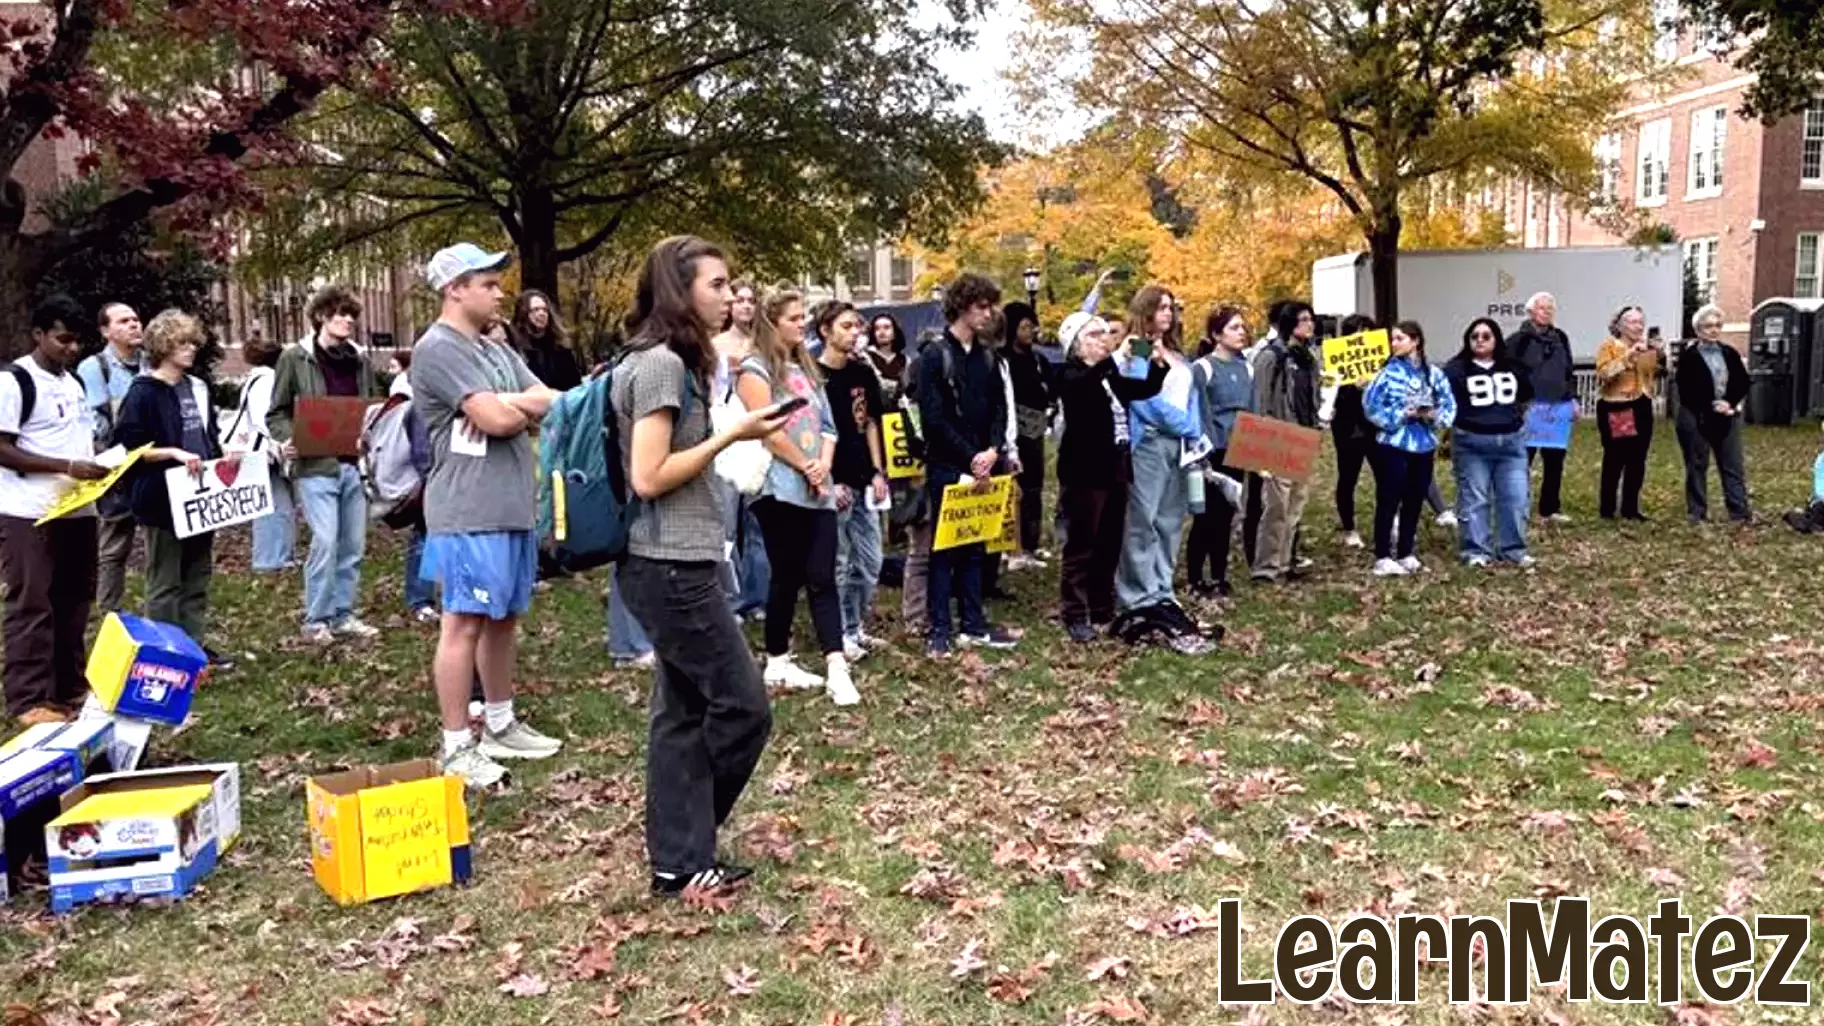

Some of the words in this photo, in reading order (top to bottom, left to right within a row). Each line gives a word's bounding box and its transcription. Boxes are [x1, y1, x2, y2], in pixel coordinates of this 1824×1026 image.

[1346, 336, 1365, 348] WE
[1329, 344, 1384, 365] DESERVE
[1466, 371, 1518, 406] 98
